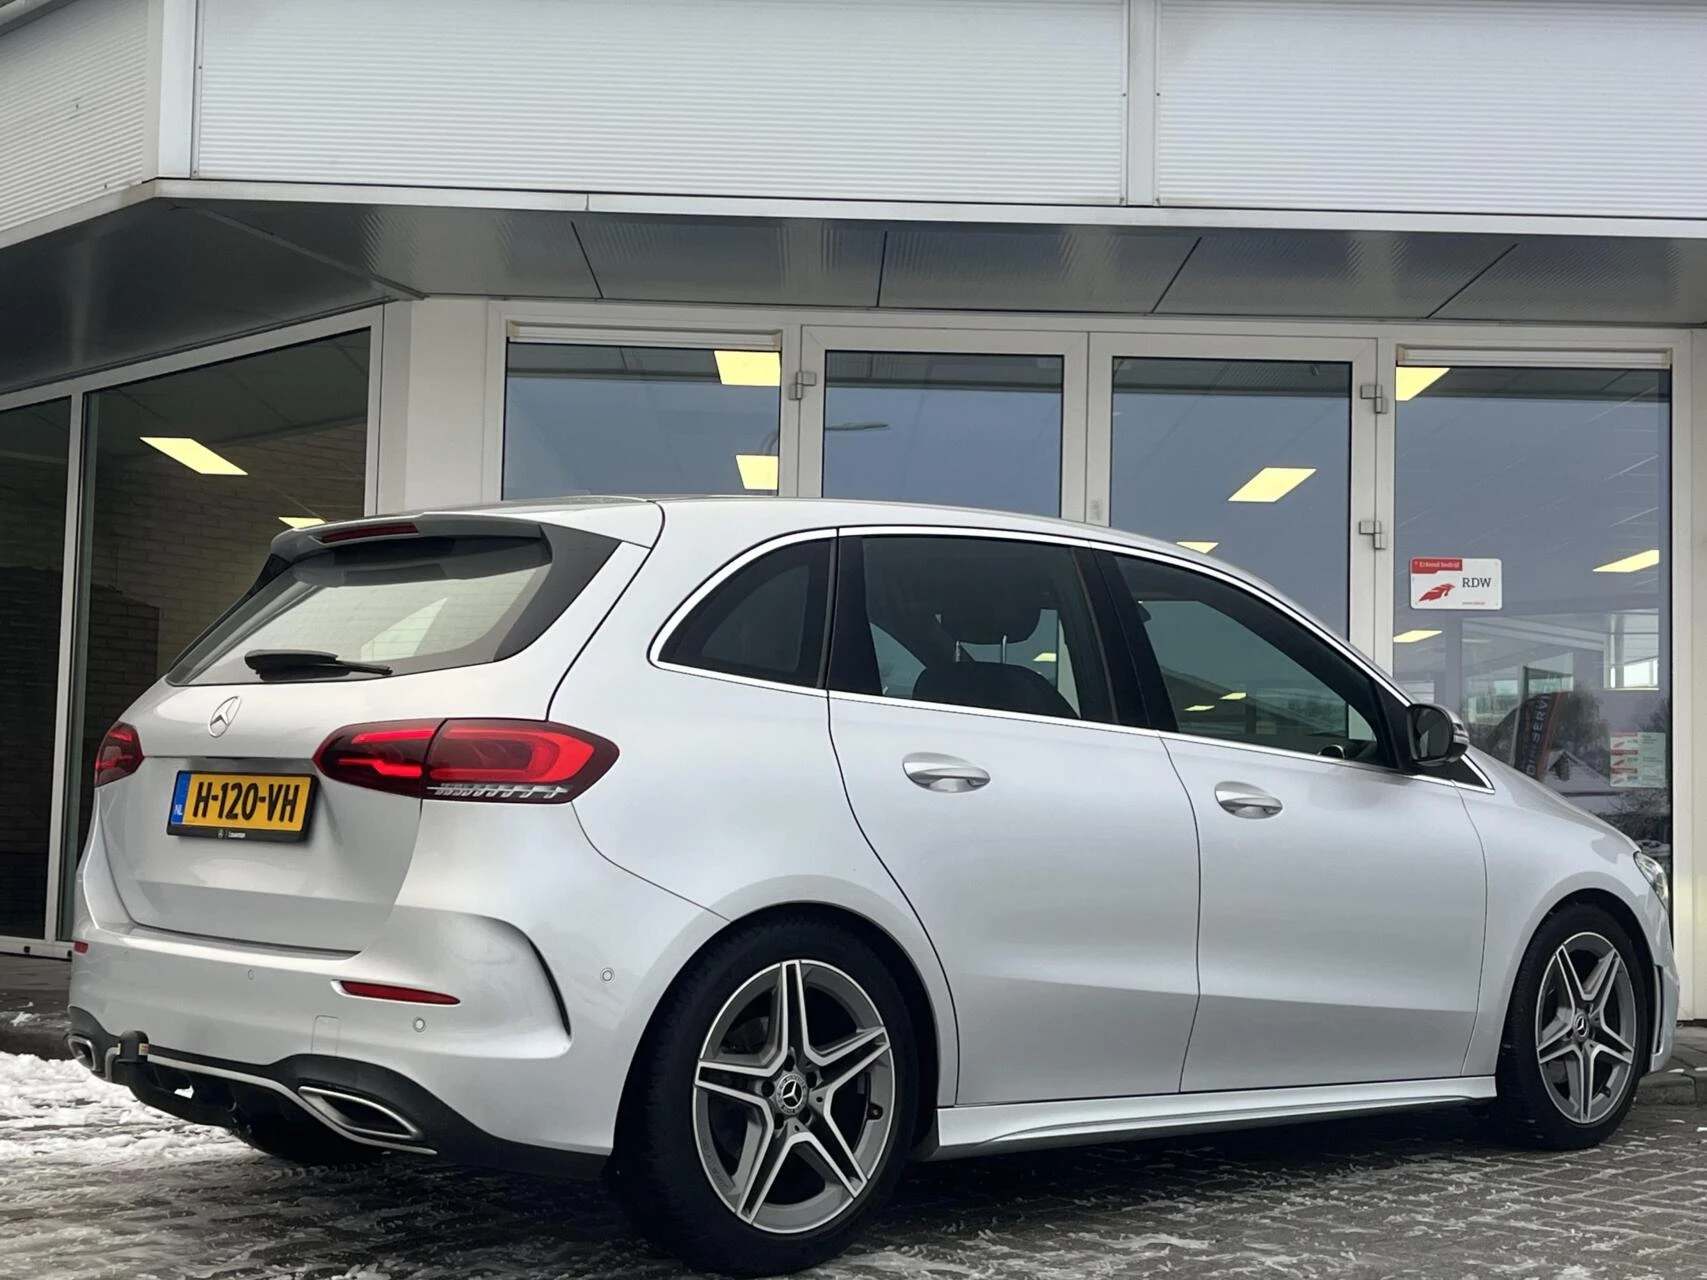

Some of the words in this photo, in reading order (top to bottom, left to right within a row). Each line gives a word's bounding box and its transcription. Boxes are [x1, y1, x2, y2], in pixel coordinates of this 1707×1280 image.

[1462, 577, 1492, 588] RDW
[192, 781, 300, 823] H-120-VH
[174, 804, 183, 816] NL
